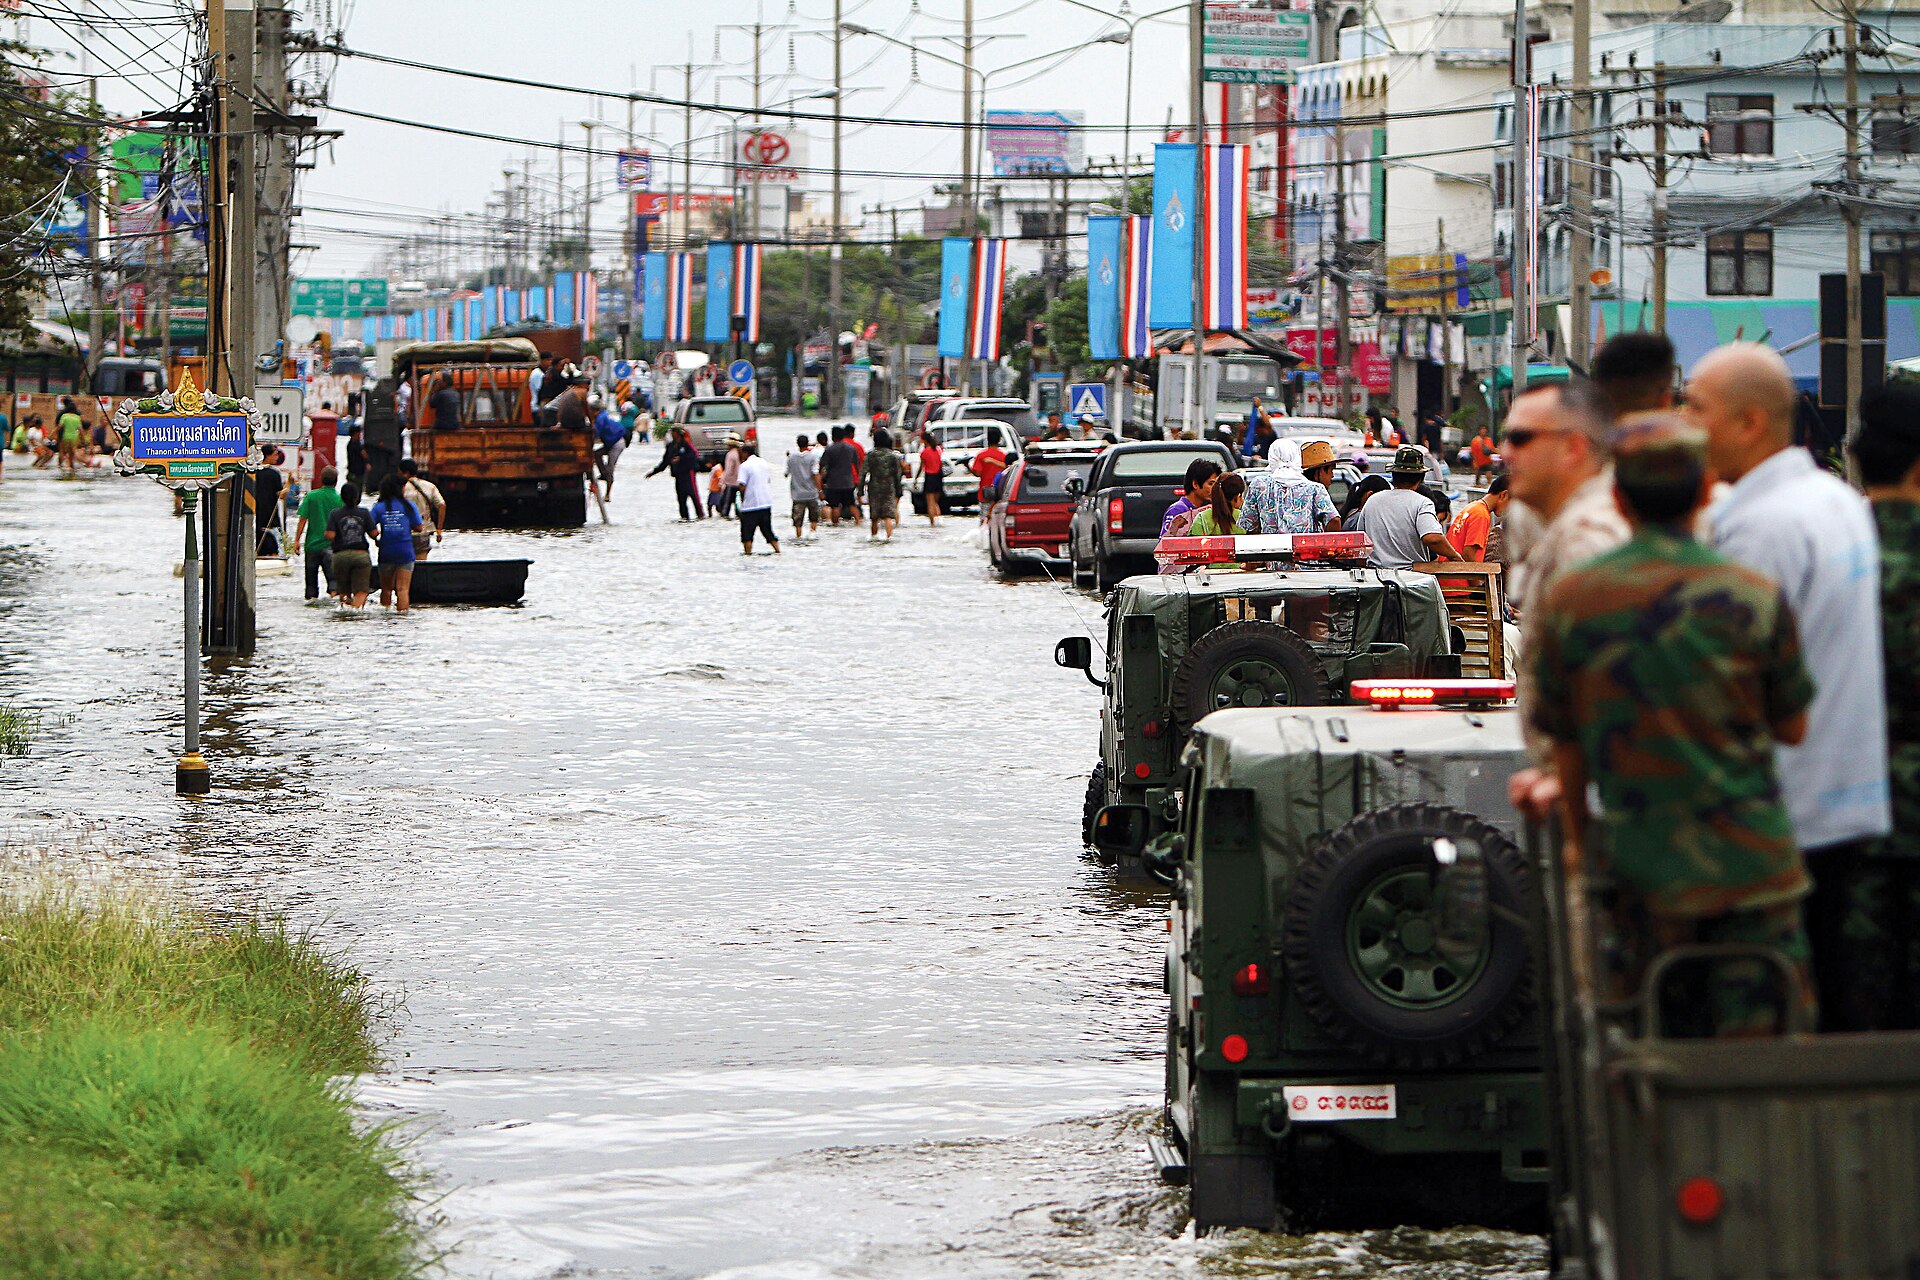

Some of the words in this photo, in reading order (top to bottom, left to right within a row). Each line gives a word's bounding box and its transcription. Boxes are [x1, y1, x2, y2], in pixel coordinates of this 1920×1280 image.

[1262, 57, 1288, 69] LPG
[263, 412, 289, 432] 3111
[140, 419, 240, 447] ถนนปทุมสามโคก
[146, 447, 172, 456] Thanon
[173, 447, 200, 455] Pathum
[200, 447, 216, 455] Sam
[217, 446, 236, 455] Khok
